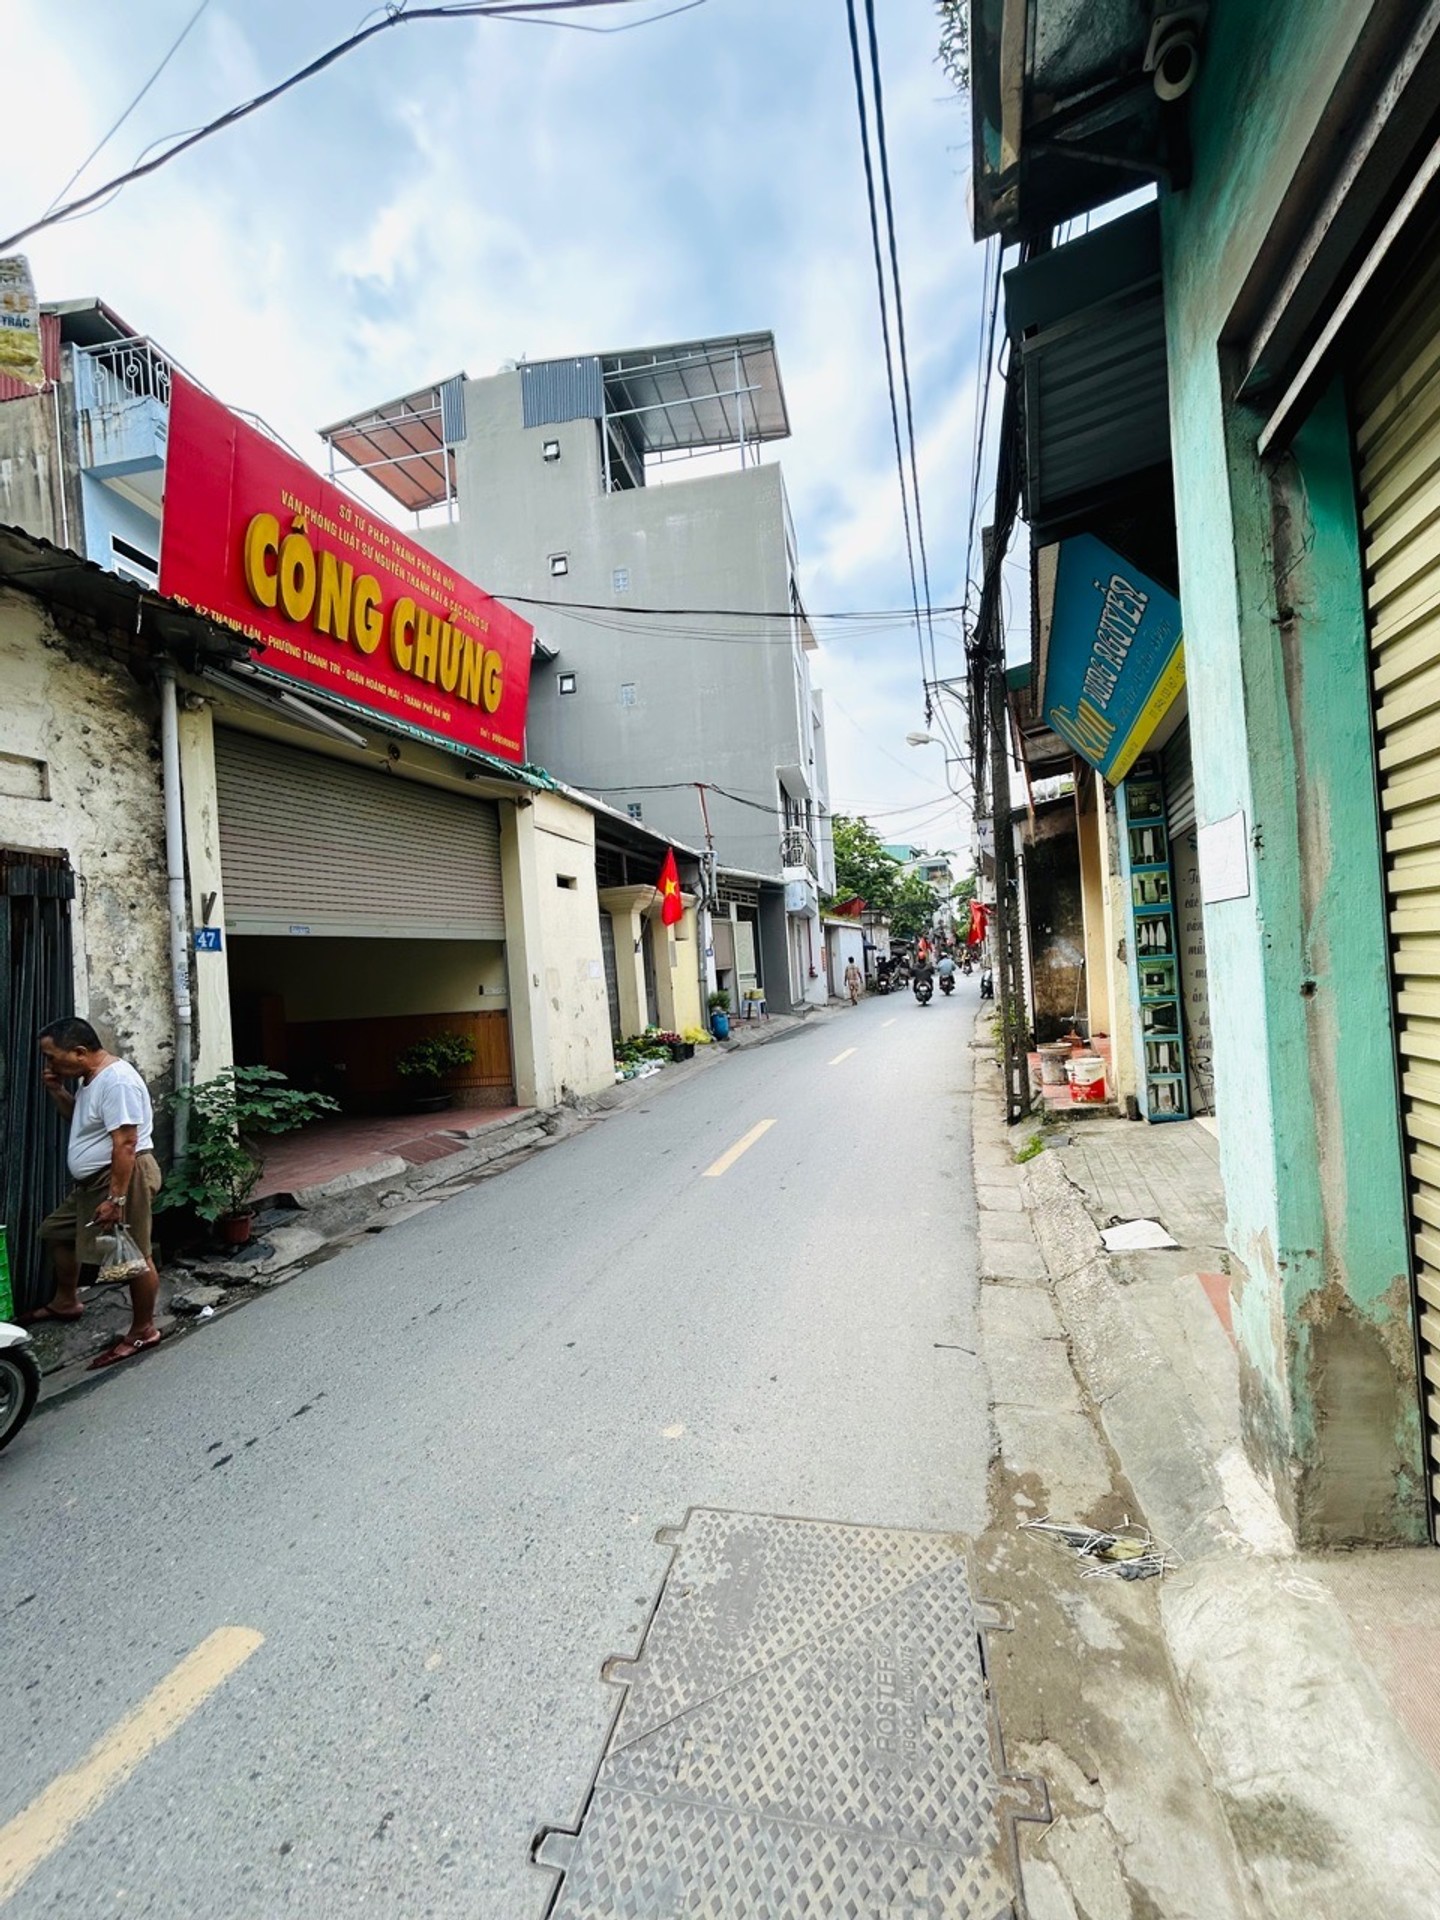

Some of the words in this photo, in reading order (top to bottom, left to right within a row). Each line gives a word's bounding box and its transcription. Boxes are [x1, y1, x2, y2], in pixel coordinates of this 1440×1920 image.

[281, 489, 303, 514] VĂN
[304, 505, 338, 538] PHÒNG
[339, 527, 361, 551] LUẬT
[361, 542, 374, 560] SƯ
[339, 503, 352, 522] SỞ
[354, 514, 366, 531] TƯ
[367, 525, 390, 547] PHÁP
[392, 541, 416, 566] THÀNH
[210, 610, 242, 632] THANH
[268, 635, 301, 658] PHƯỜNG
[303, 650, 329, 670] THANH
[245, 512, 383, 656] CÔNG
[391, 598, 503, 713] CHỨNG
[1051, 697, 1116, 764] Rèm
[197, 931, 216, 948] 47
